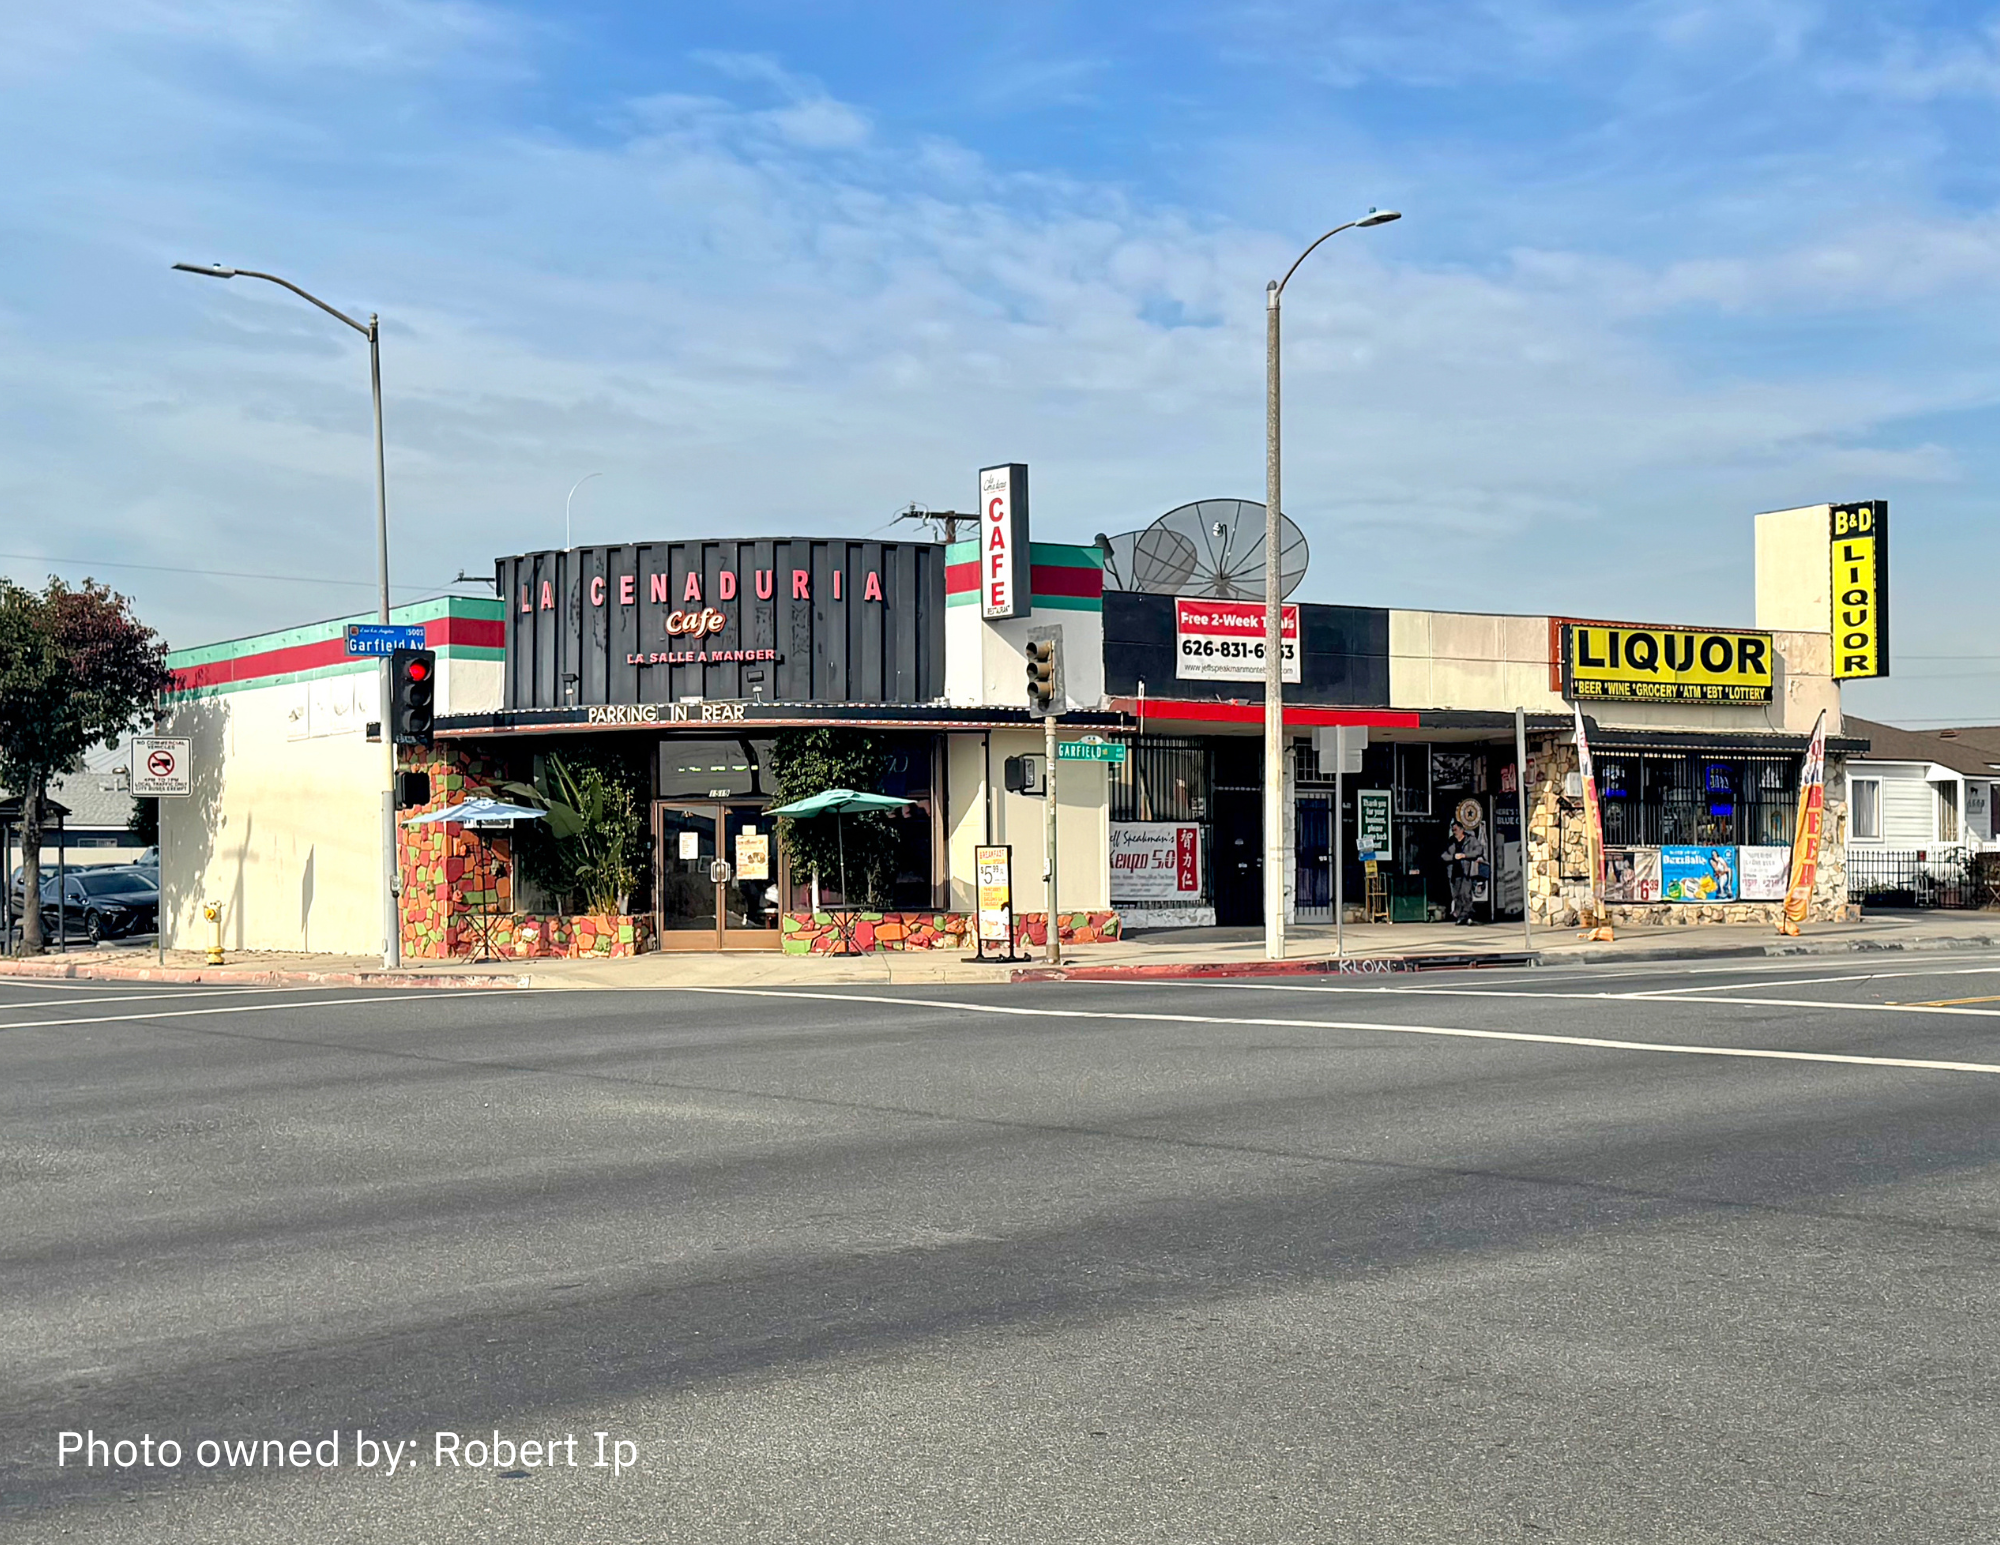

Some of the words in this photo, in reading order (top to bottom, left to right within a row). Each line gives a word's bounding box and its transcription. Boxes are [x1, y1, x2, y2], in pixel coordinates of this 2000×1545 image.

[1835, 508, 1872, 535] B&D
[988, 497, 1005, 606] CAFE
[521, 581, 554, 613] LA
[590, 570, 883, 607] CENADURIA
[1841, 545, 1869, 672] LIQUOR
[665, 607, 727, 640] Cafe
[1180, 612, 1209, 626] Free
[1211, 613, 1259, 628] 2-Week
[349, 639, 406, 652] Garfield
[1578, 629, 1768, 675] LIQUOR
[627, 654, 645, 664] LA
[649, 652, 694, 664] SALLE
[697, 651, 708, 662] A
[711, 649, 777, 662] MANGER
[1635, 684, 1678, 698] GROCERY
[1728, 688, 1766, 701] LOTTERY
[588, 705, 657, 724] PARKING
[671, 704, 687, 723] IN
[702, 704, 745, 722] REAR
[1058, 745, 1102, 758] GARFIELD
[1110, 830, 1121, 847] eff
